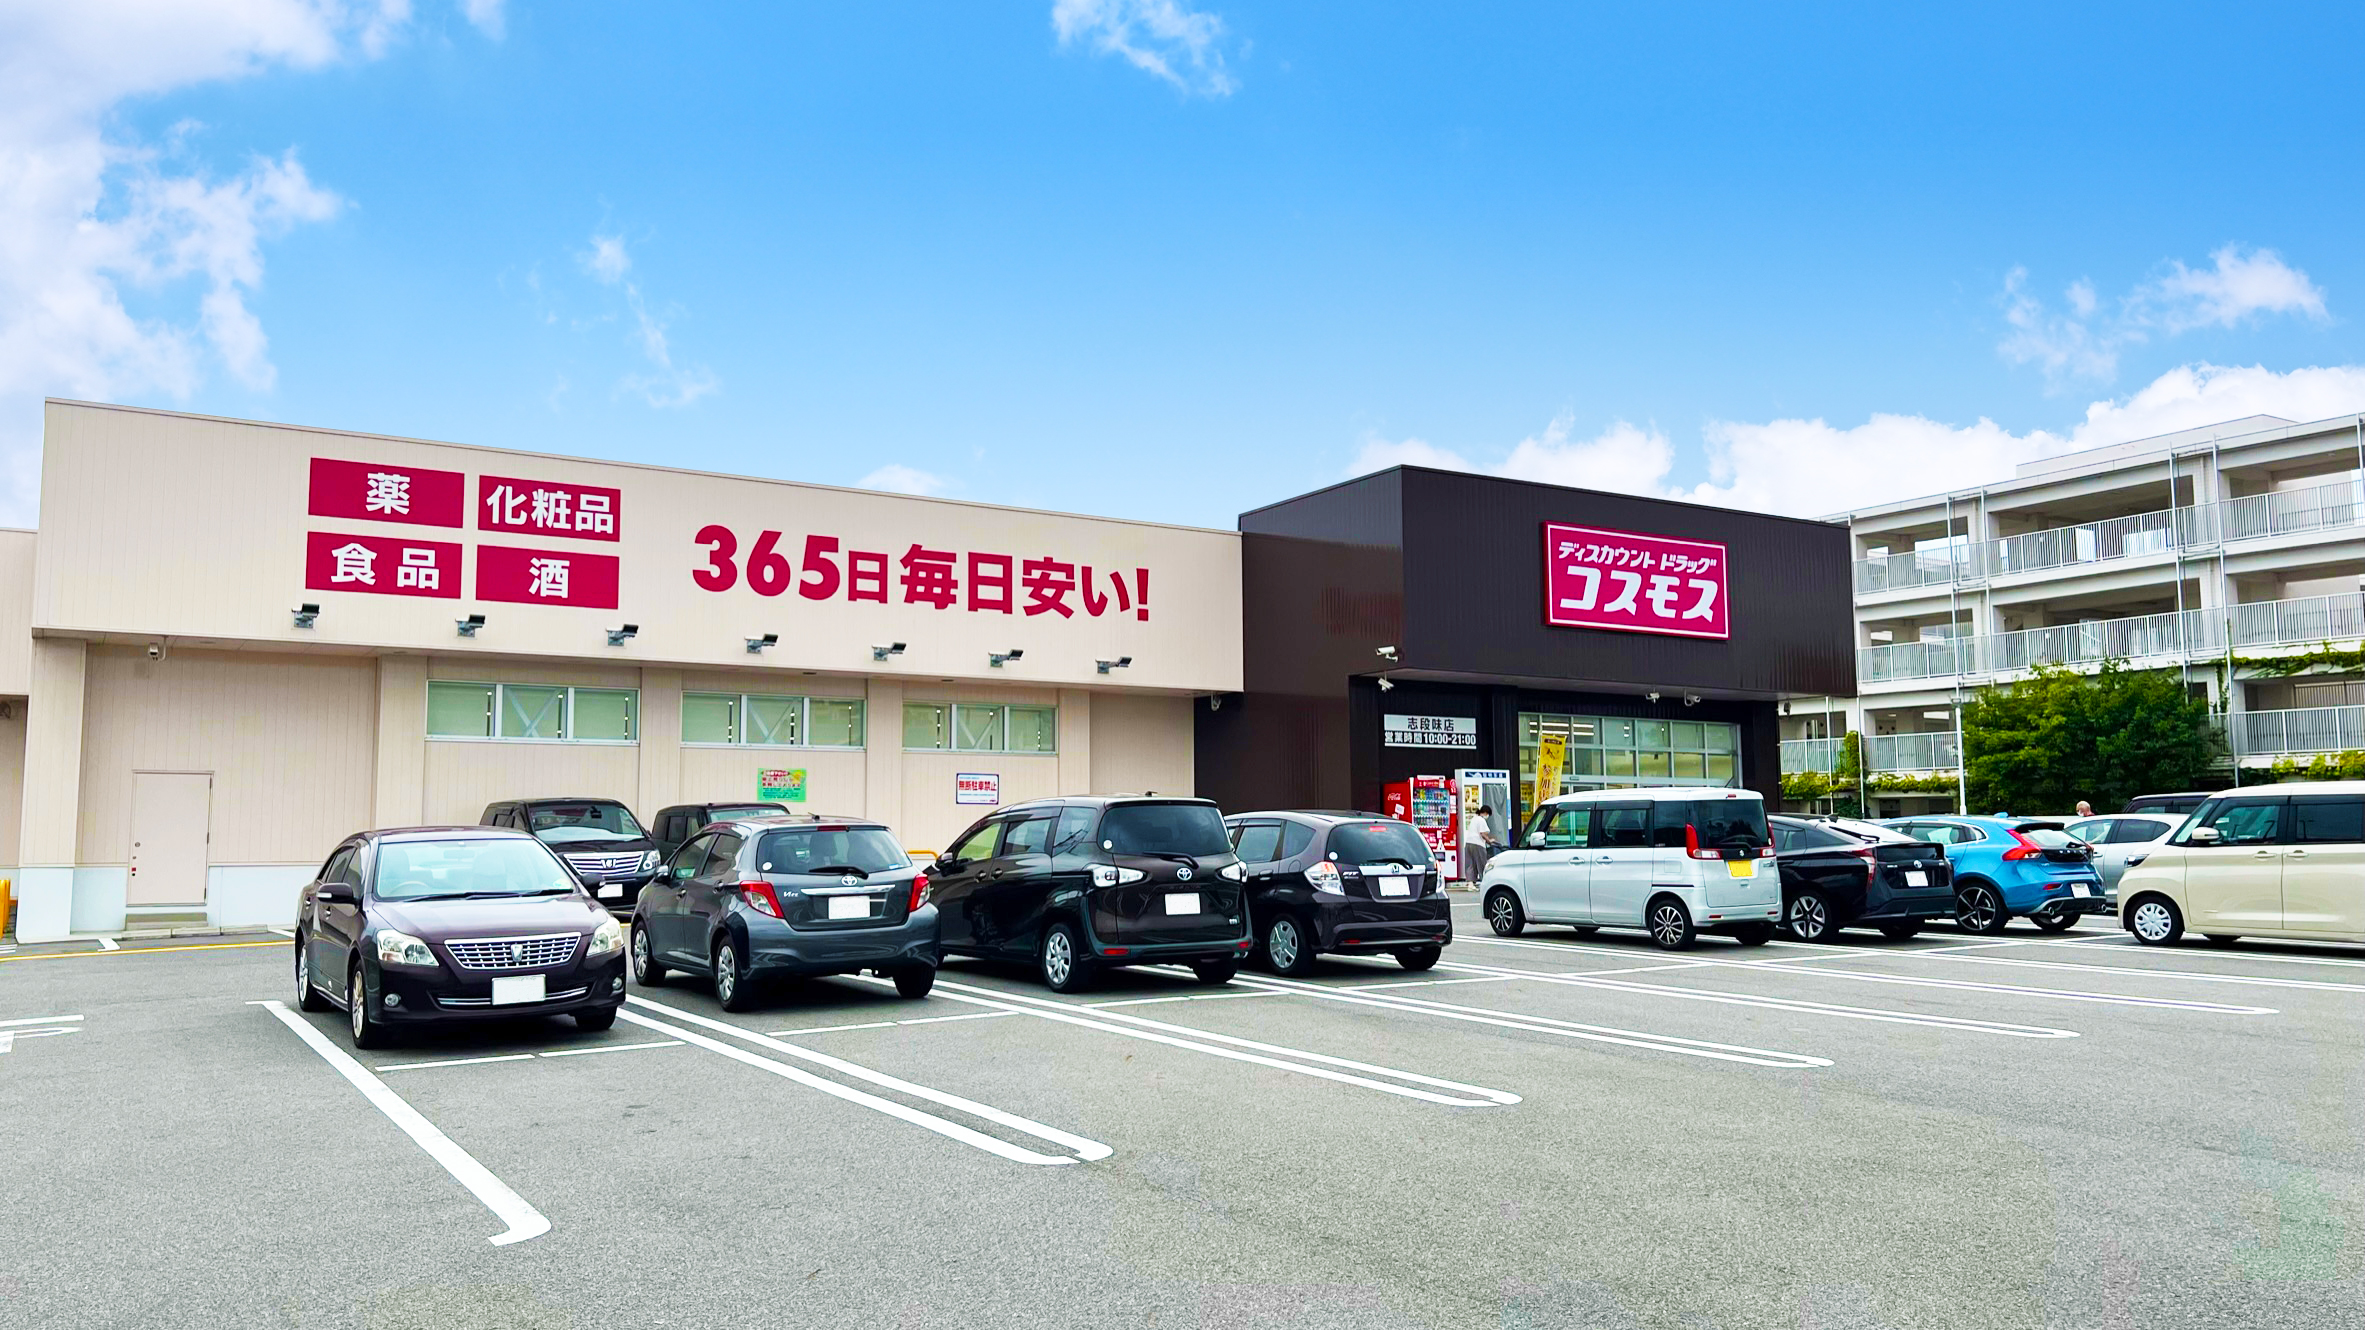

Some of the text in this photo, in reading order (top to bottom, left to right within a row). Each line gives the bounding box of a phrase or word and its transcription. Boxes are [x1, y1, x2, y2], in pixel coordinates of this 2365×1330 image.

[366, 472, 411, 515] 薬
[486, 484, 614, 535] 化粧品
[331, 542, 440, 590] 食品
[528, 557, 570, 599] 酒
[1558, 541, 1718, 575] ディスカウント ドラッグ
[1560, 565, 1719, 623] コスモス
[1407, 716, 1455, 732] 志段味店
